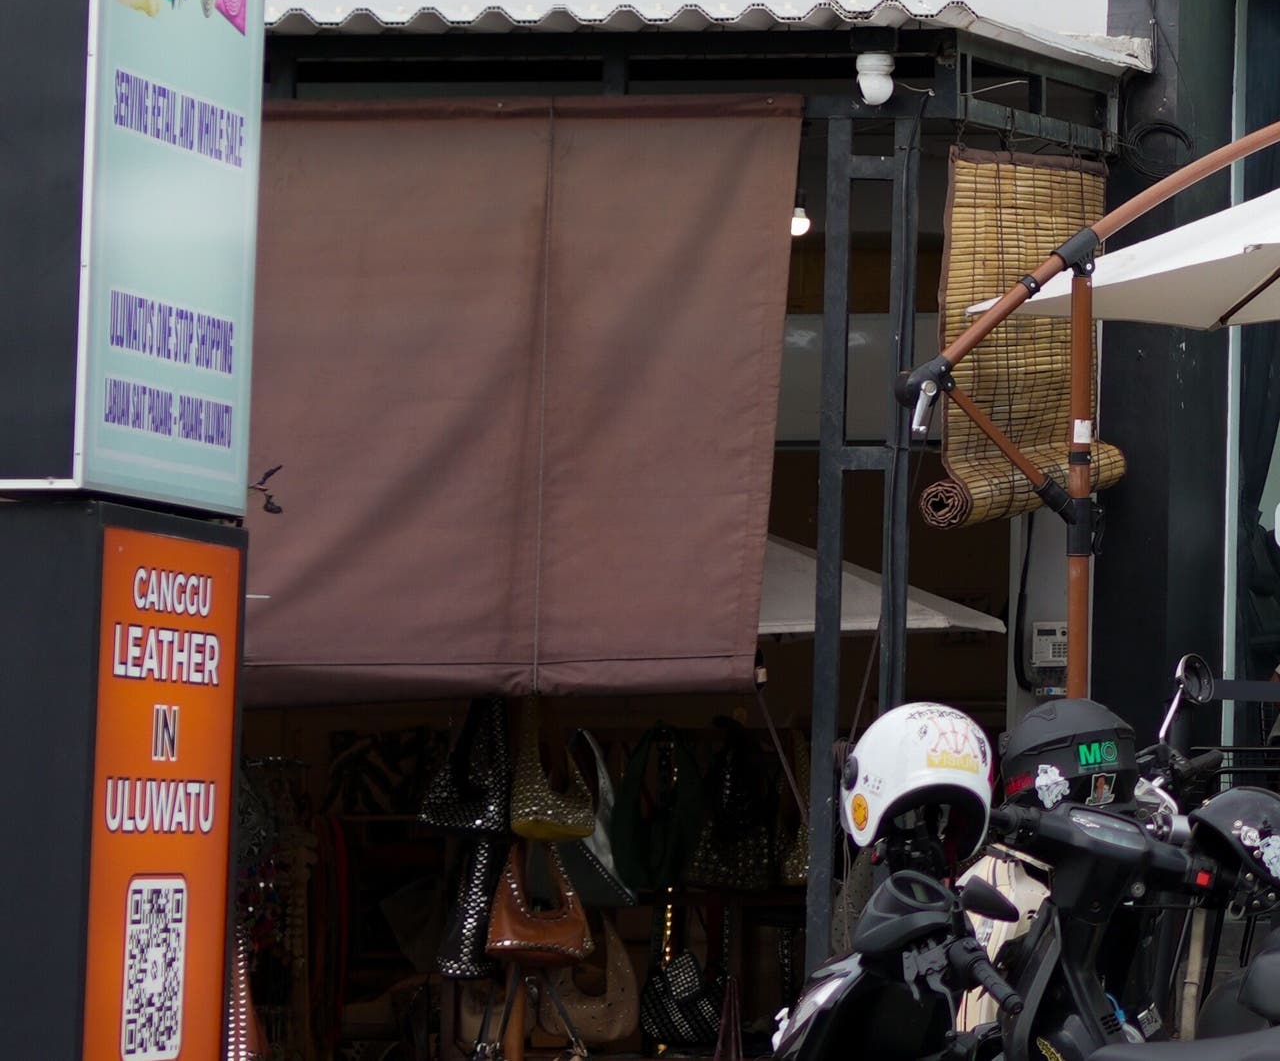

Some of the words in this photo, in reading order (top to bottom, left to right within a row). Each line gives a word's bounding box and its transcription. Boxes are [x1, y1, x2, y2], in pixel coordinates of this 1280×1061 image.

[113, 68, 149, 135] SERVING
[150, 83, 177, 146] RETAIL
[179, 94, 195, 152] AND
[197, 99, 224, 161] WHOLE
[225, 110, 244, 169] SALE
[109, 289, 155, 356] ULUWATU'S
[156, 302, 173, 360] ONE
[173, 306, 194, 365] STOP
[195, 312, 233, 375] SHOPPING
[204, 400, 233, 449] ULUWATU
[133, 565, 213, 618] CANGGU
[111, 622, 220, 686] LEATHER
[151, 704, 181, 762] IN
[104, 776, 217, 834] ULUWATU
